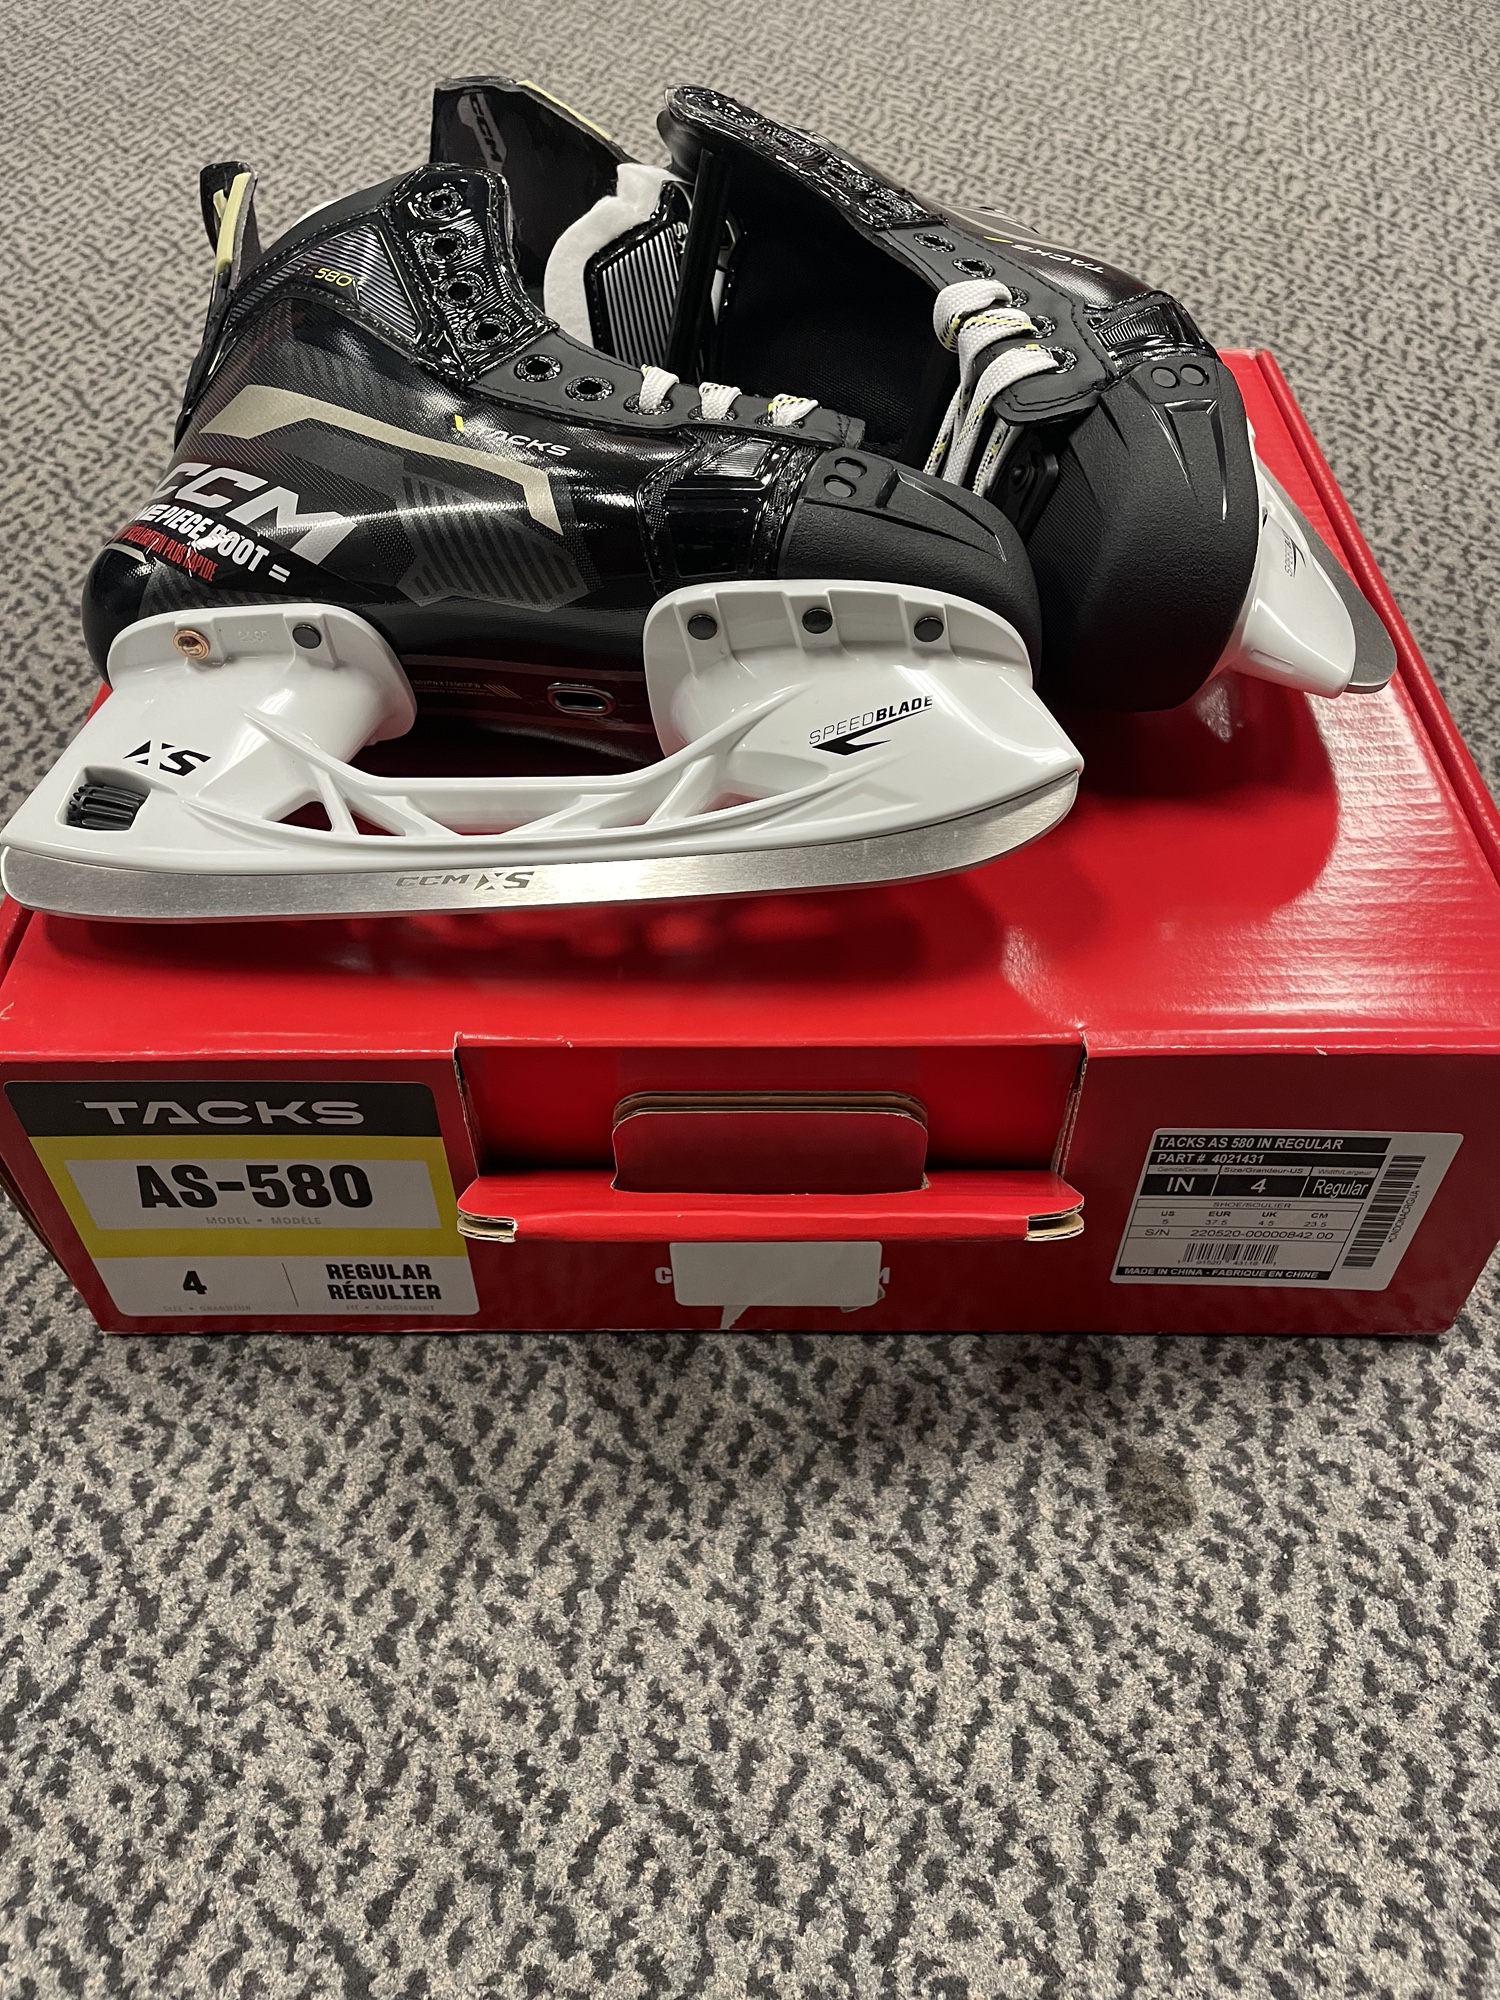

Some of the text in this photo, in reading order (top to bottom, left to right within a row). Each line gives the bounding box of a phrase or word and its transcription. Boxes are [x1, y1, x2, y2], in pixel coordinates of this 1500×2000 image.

[314, 267, 353, 287] 580
[151, 462, 358, 565] CCM
[154, 505, 214, 539] PIECE
[809, 695, 933, 745] SPEEDBLADE
[395, 870, 535, 891] CCM XS
[84, 1101, 364, 1125] TACKS
[1159, 1137, 1344, 1150] TACKS AS 580 IN REGULAR
[1157, 1153, 1196, 1163] PART
[1211, 1154, 1265, 1164] 4021431
[136, 1164, 373, 1208] AS-580
[1166, 1177, 1196, 1193] IN
[1250, 1178, 1267, 1194] 4
[1312, 1179, 1370, 1198] Regular
[205, 1216, 251, 1225] MODEL
[1144, 1228, 1171, 1237] S/N
[325, 1264, 432, 1280] REGULAR
[1124, 1267, 1156, 1275] MADE
[1170, 1268, 1203, 1276] CHINA
[1211, 1268, 1267, 1277] FABRIQUE
[1268, 1270, 1284, 1278] EN
[1285, 1270, 1320, 1279] CHINE
[183, 1270, 207, 1295] 4
[327, 1280, 442, 1300] RÉGULIER
